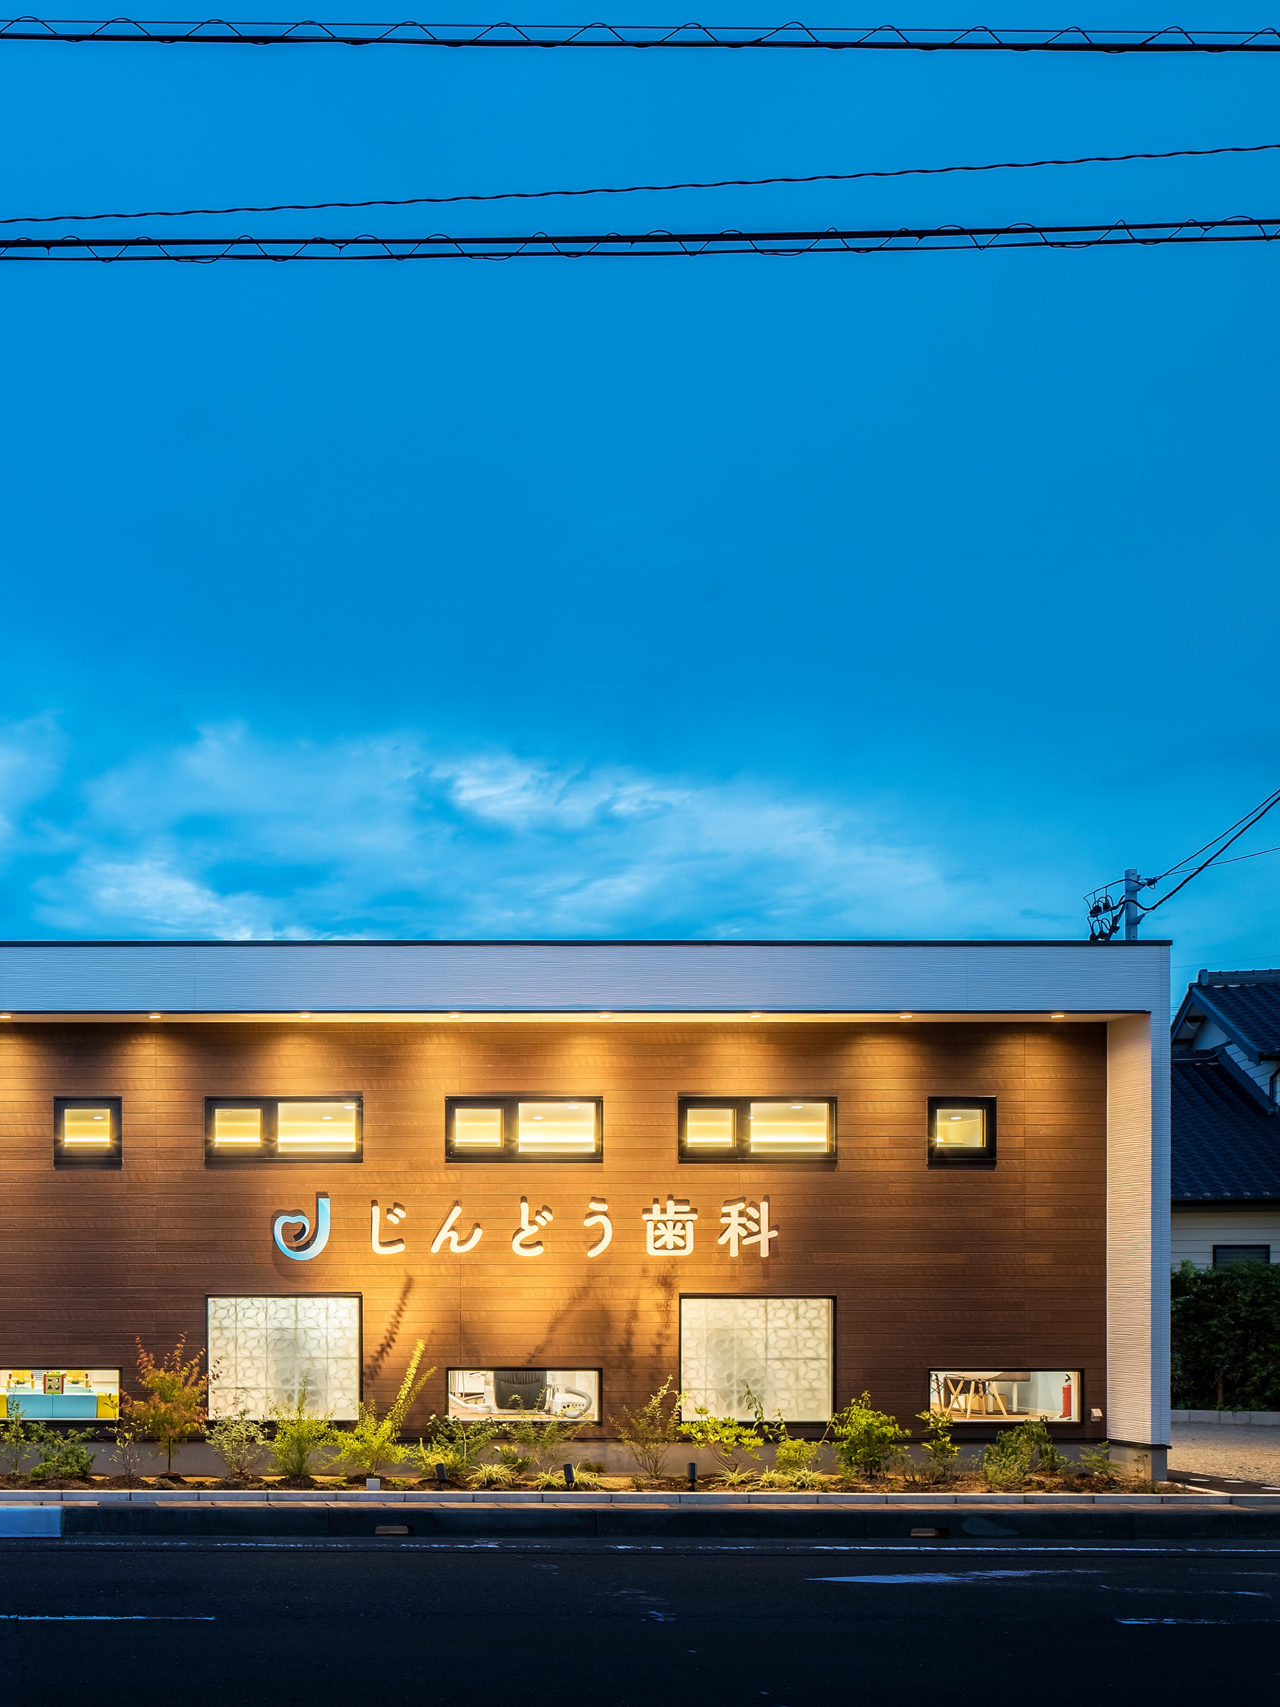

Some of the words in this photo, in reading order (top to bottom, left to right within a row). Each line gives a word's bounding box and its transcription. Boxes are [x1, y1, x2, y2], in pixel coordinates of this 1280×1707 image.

[371, 1200, 779, 1257] じんどう歯科
